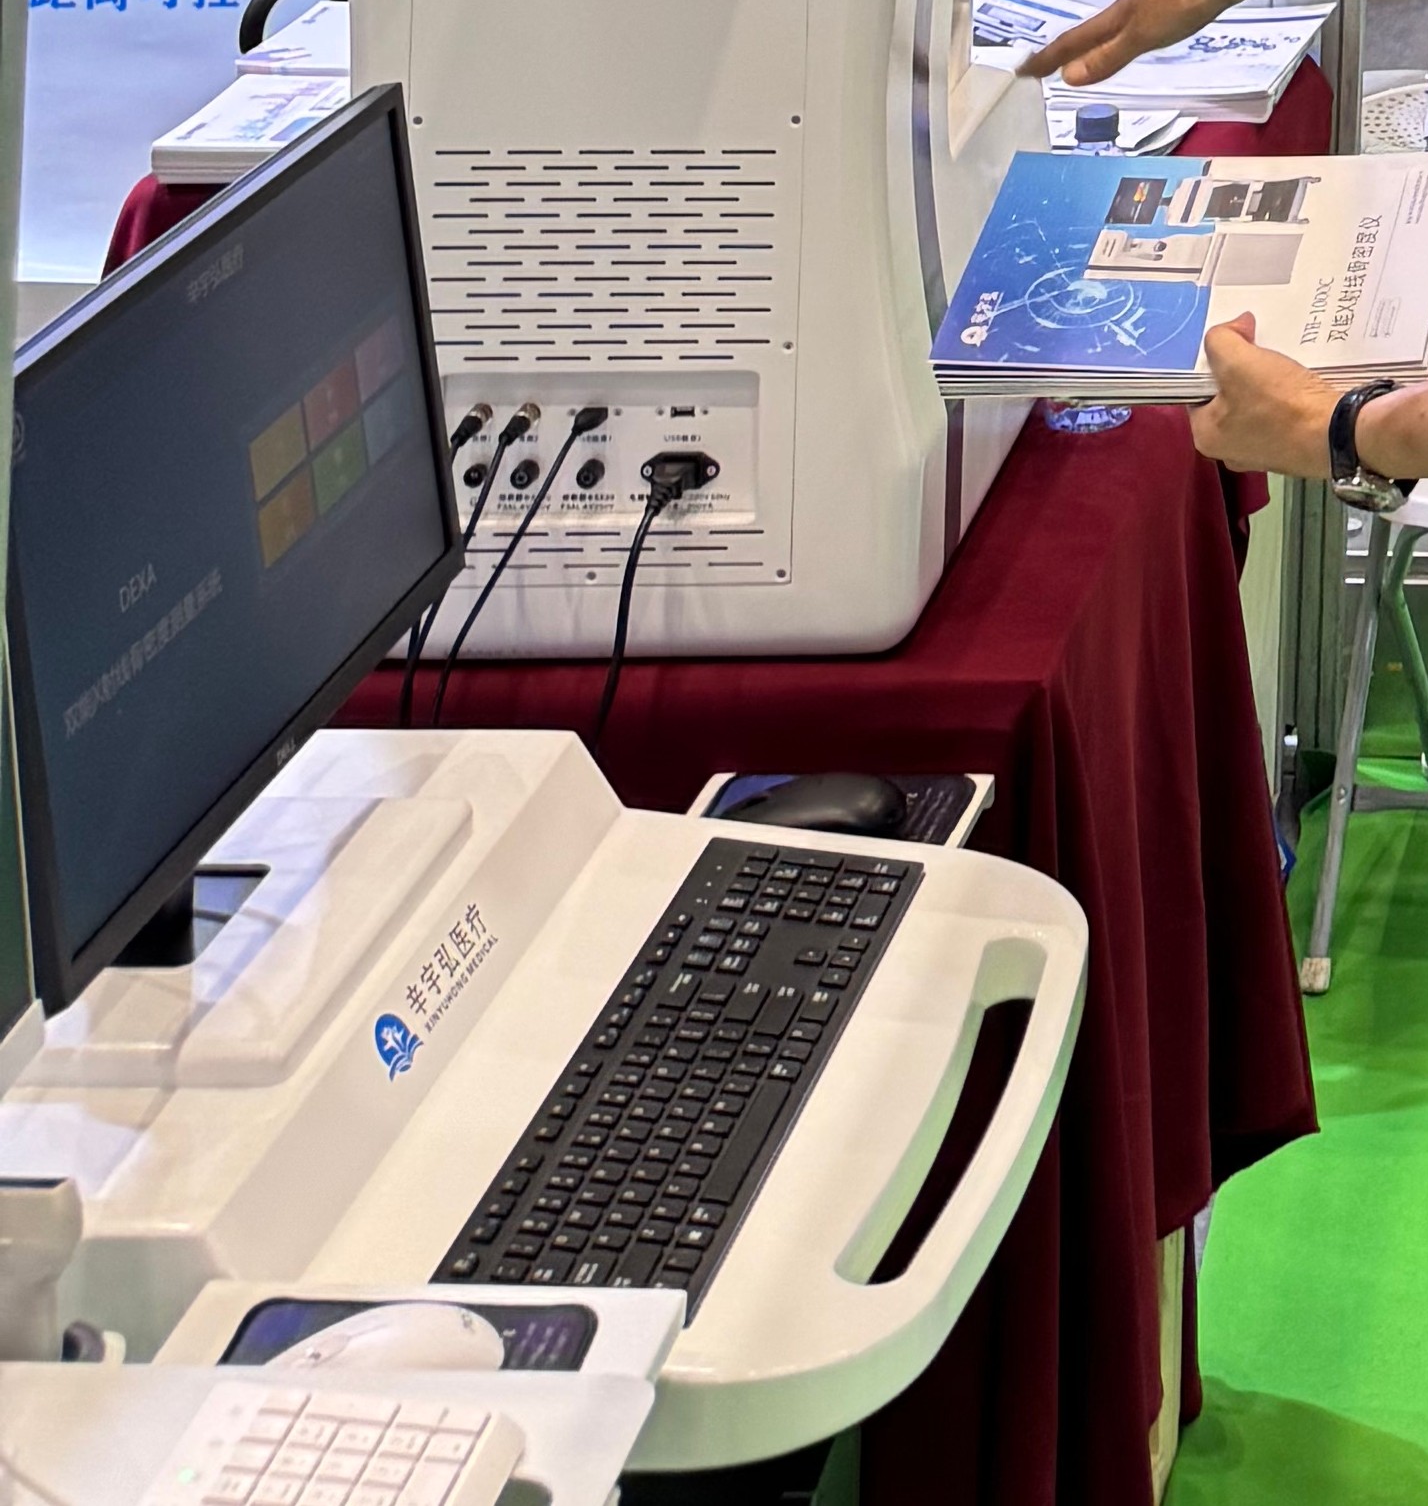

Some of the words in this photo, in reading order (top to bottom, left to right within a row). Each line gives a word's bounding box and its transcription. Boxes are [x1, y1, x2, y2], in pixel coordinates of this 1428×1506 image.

[119, 561, 158, 614] DEXA
[405, 902, 487, 1016] 辛宇弘医疗
[423, 971, 469, 1034] XINYUHONG
[464, 933, 500, 977] MEDICAL
